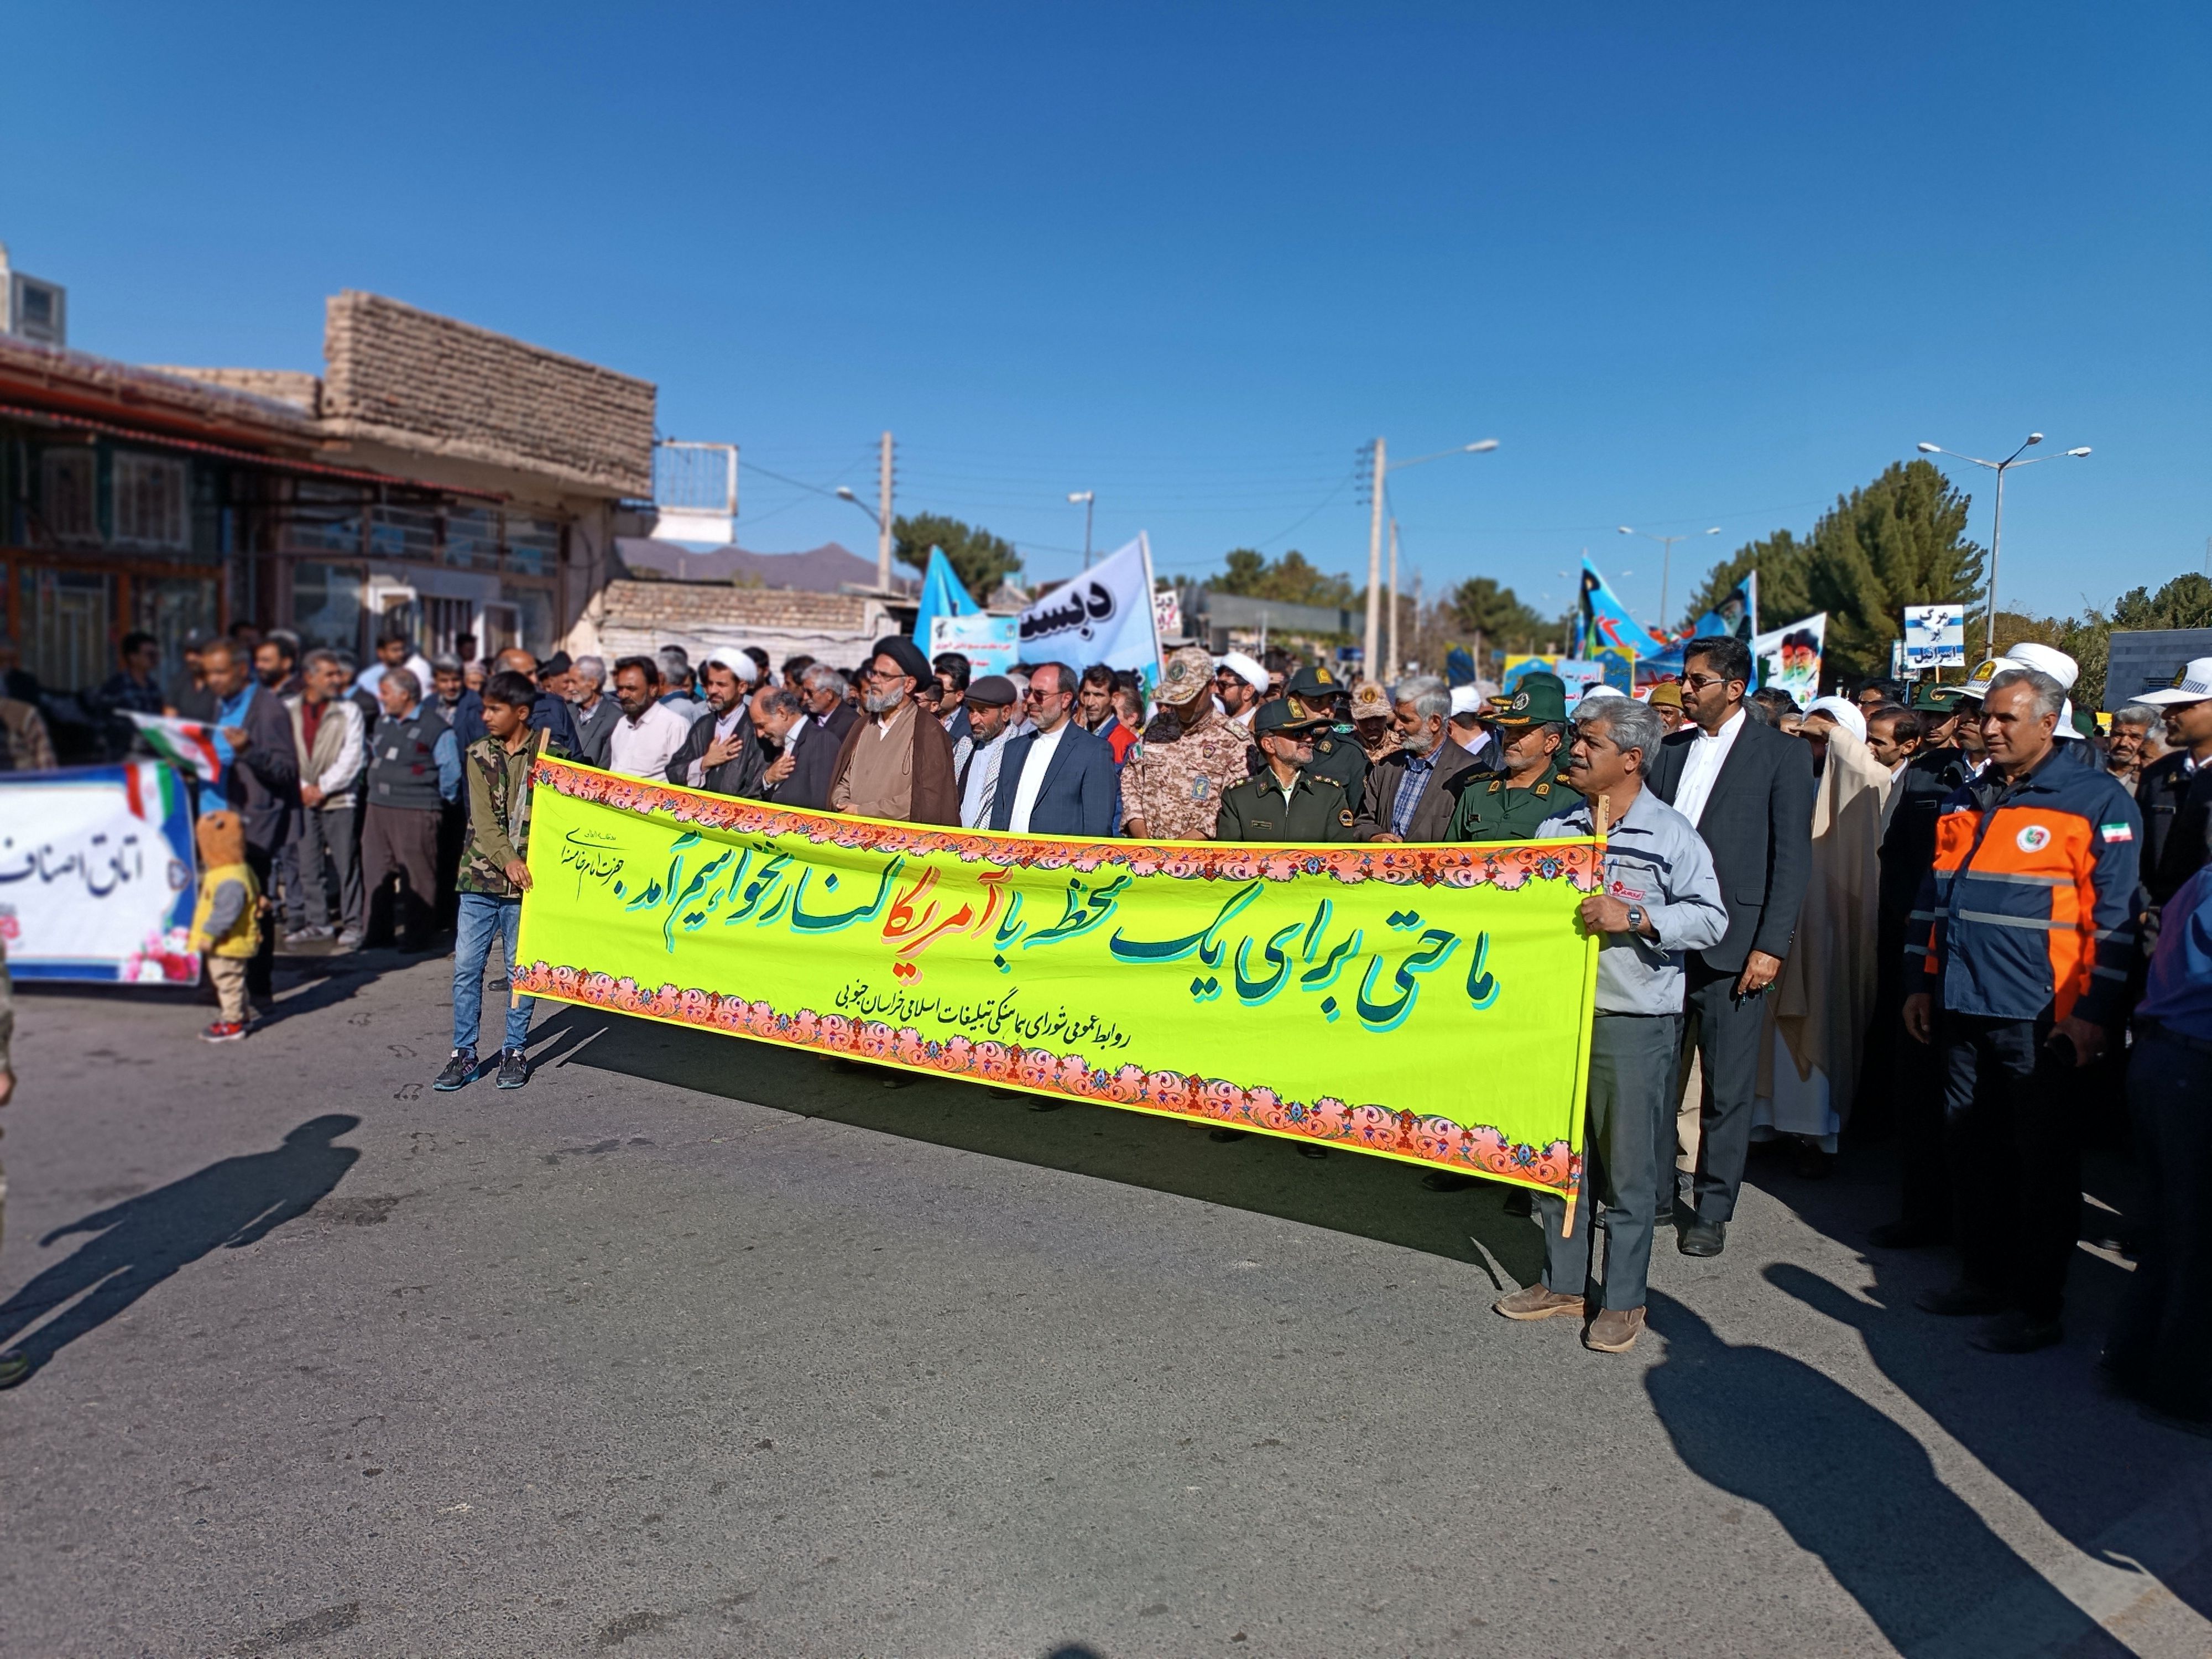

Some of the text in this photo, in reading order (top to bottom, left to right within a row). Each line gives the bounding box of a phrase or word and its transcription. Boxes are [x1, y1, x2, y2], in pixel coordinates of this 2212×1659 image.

[1914, 646, 1956, 664] اسرائیل
[1919, 608, 1948, 624] مرگ
[1931, 628, 1942, 641] بر
[0, 833, 143, 899] اتاق اصناف
[576, 852, 601, 902] امام
[596, 857, 625, 886] حضرت
[664, 841, 796, 953] نخواهیم
[757, 855, 906, 935] کنار
[880, 865, 1014, 986] آمریکا
[993, 890, 1027, 973] با
[1022, 874, 1133, 951] لحظه
[1109, 880, 1265, 1003] یک
[1234, 899, 1363, 1023] برای
[1357, 910, 1462, 1033] حتی
[1467, 931, 1500, 1010] ما
[835, 978, 1132, 1050] روابط عمومی شورای هماهنگی تبلیغات اسلامی خراسان جنوبی
